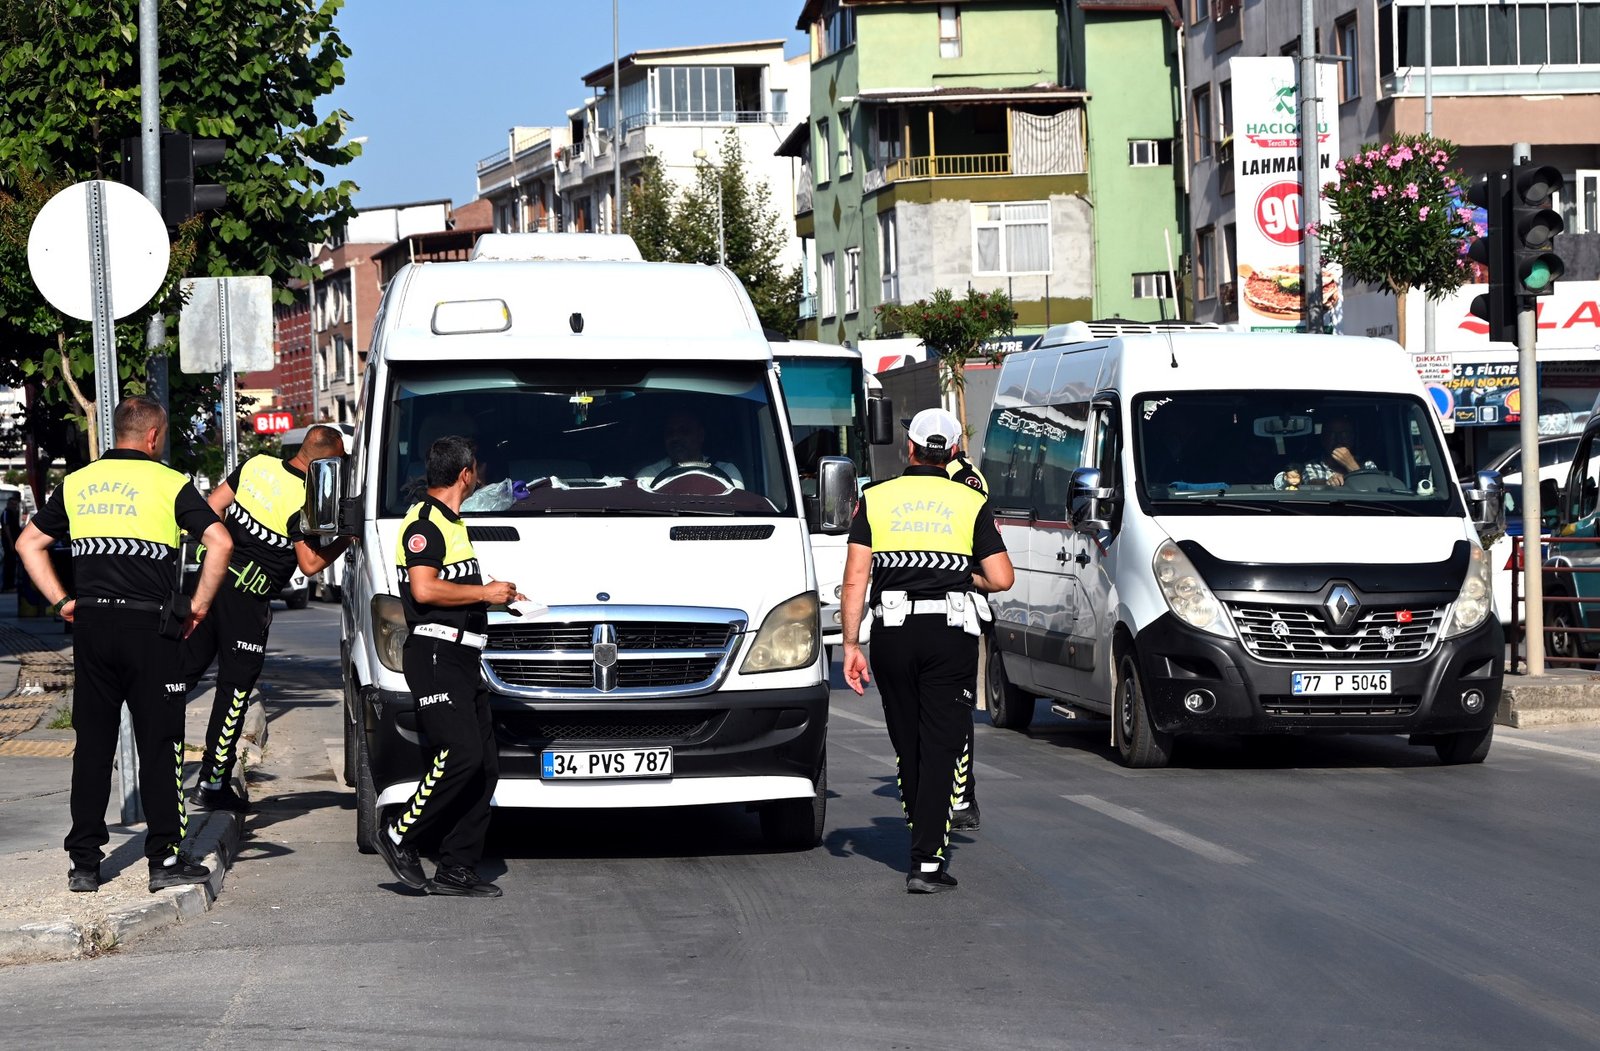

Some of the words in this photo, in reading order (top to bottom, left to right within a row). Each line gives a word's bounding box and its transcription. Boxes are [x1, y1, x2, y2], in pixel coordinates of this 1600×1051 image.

[1246, 123, 1328, 134] HACIOU
[1242, 153, 1330, 176] LAHMAN
[1261, 193, 1304, 235] 90
[1477, 364, 1518, 375] FİLTRE
[1478, 376, 1520, 388] NOKTA
[257, 414, 290, 431] BİM
[77, 481, 139, 501] TRAFİK
[77, 503, 137, 516] ZABITA
[891, 500, 954, 520] TRAFİK
[890, 520, 953, 535] ZABITA
[236, 640, 264, 653] TRAFİK
[1303, 675, 1321, 692] 77
[1335, 675, 1344, 691] P
[1352, 674, 1388, 691] 5046
[419, 692, 450, 707] TRAFİK
[544, 765, 553, 773] TR
[554, 754, 578, 775] 34
[589, 752, 625, 774] PVS
[634, 750, 670, 773] 787
